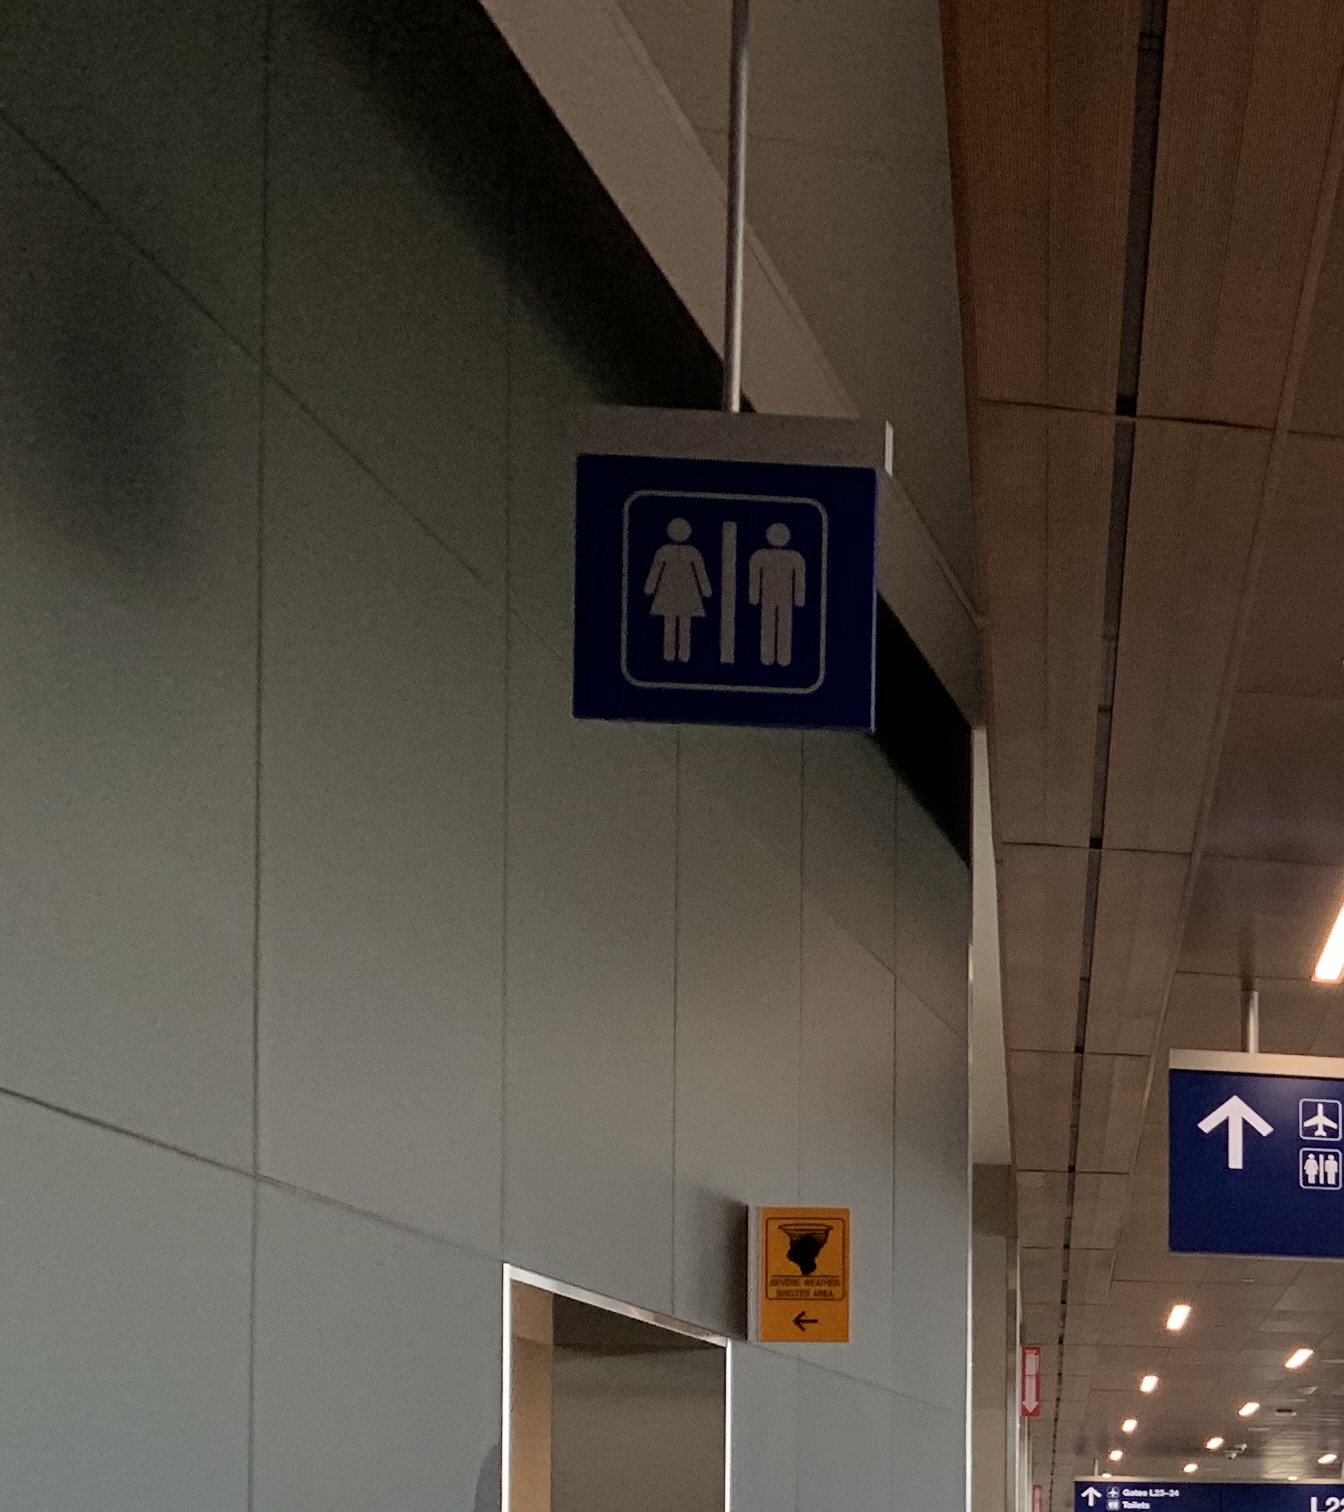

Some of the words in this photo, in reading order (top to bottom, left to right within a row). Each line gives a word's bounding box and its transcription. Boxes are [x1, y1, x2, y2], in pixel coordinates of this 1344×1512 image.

[804, 1279, 840, 1287] WEATHER
[813, 1289, 833, 1297] AREA
[1122, 1488, 1148, 1497] Gates
[1122, 1501, 1151, 1510] Toilets
